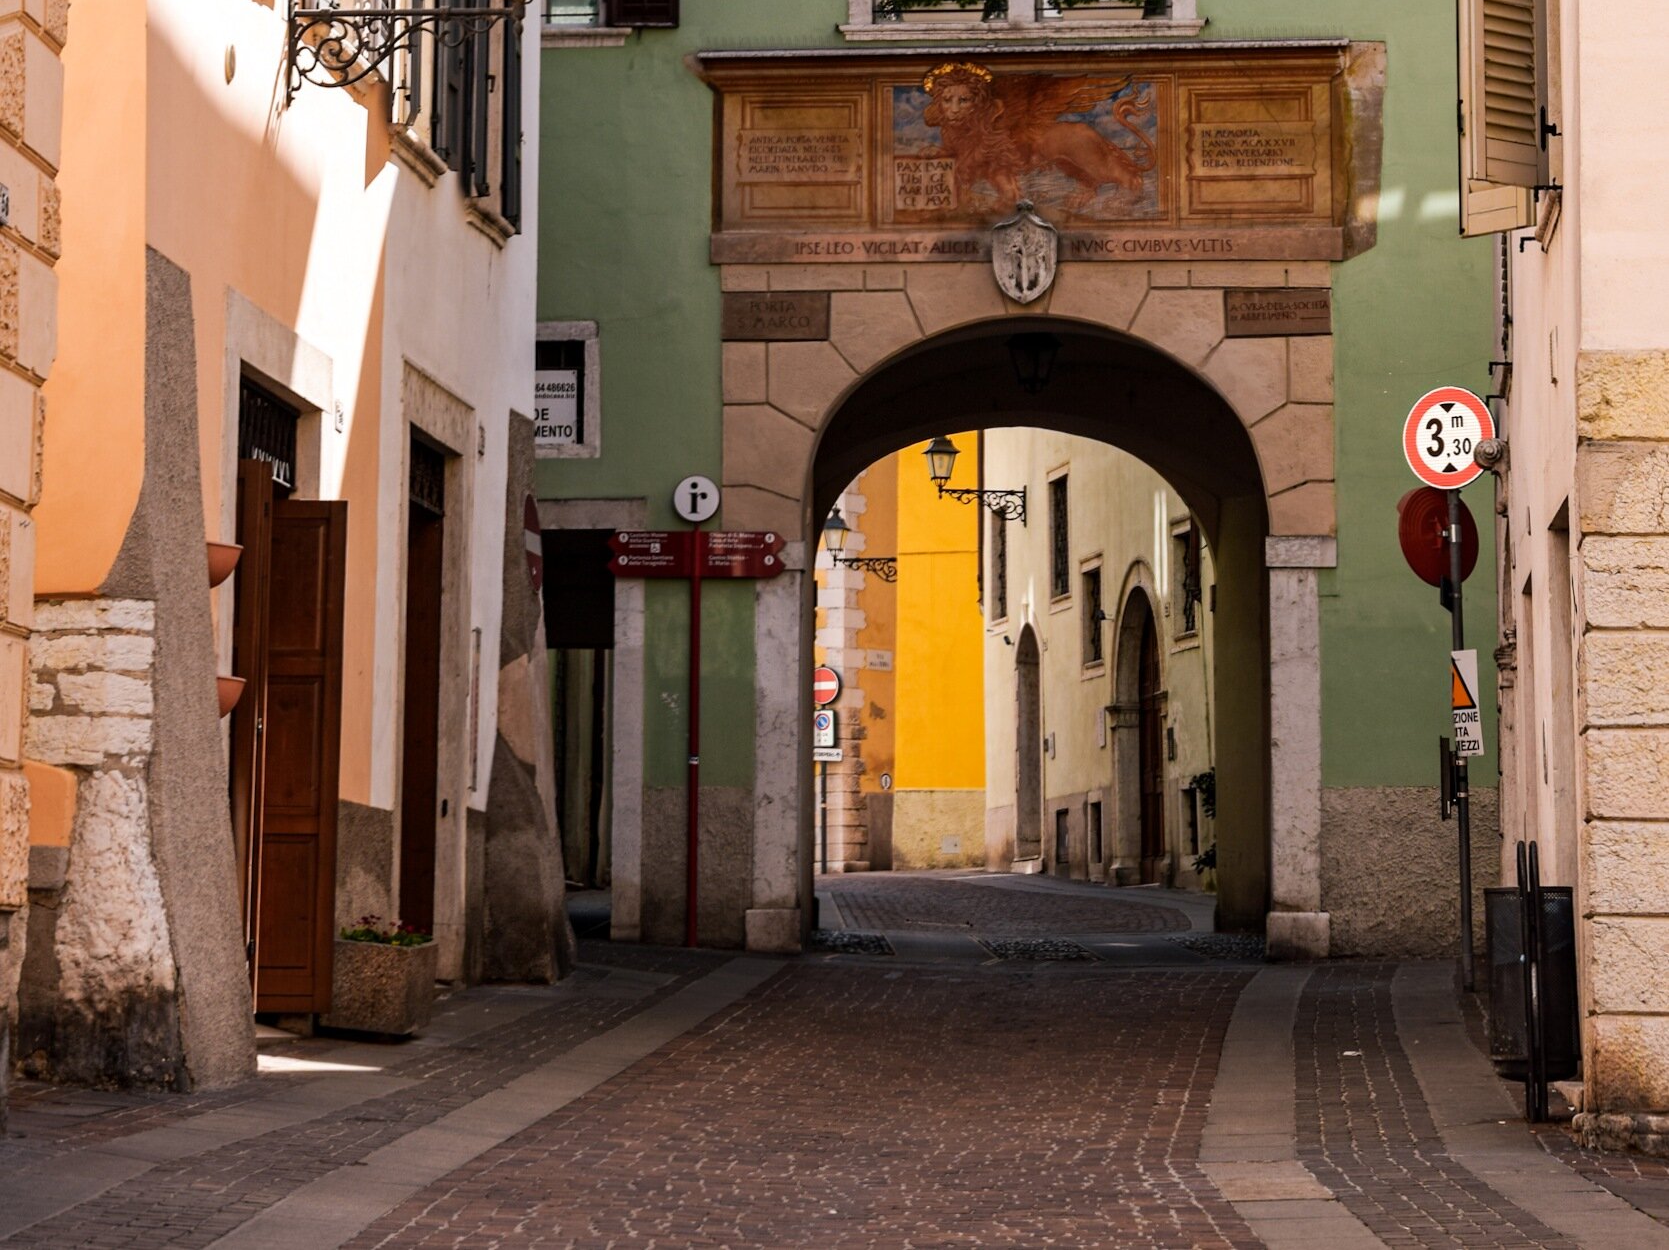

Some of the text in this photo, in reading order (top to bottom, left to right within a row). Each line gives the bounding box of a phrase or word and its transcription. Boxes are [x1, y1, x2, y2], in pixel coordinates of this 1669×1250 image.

[1202, 129, 1261, 138] IN MEMORIA
[1215, 149, 1284, 158] ANNIVERSARIO
[897, 162, 922, 173] PAX
[1236, 158, 1294, 167] REDENZIONE
[898, 185, 922, 196] MAR
[795, 241, 824, 255] IPSE
[827, 241, 855, 255] LEO
[1071, 238, 1233, 253] NVNC CIVIBVS VLTIS
[750, 300, 797, 313] PORTA
[753, 316, 811, 329] MARCO
[1451, 415, 1464, 428] m
